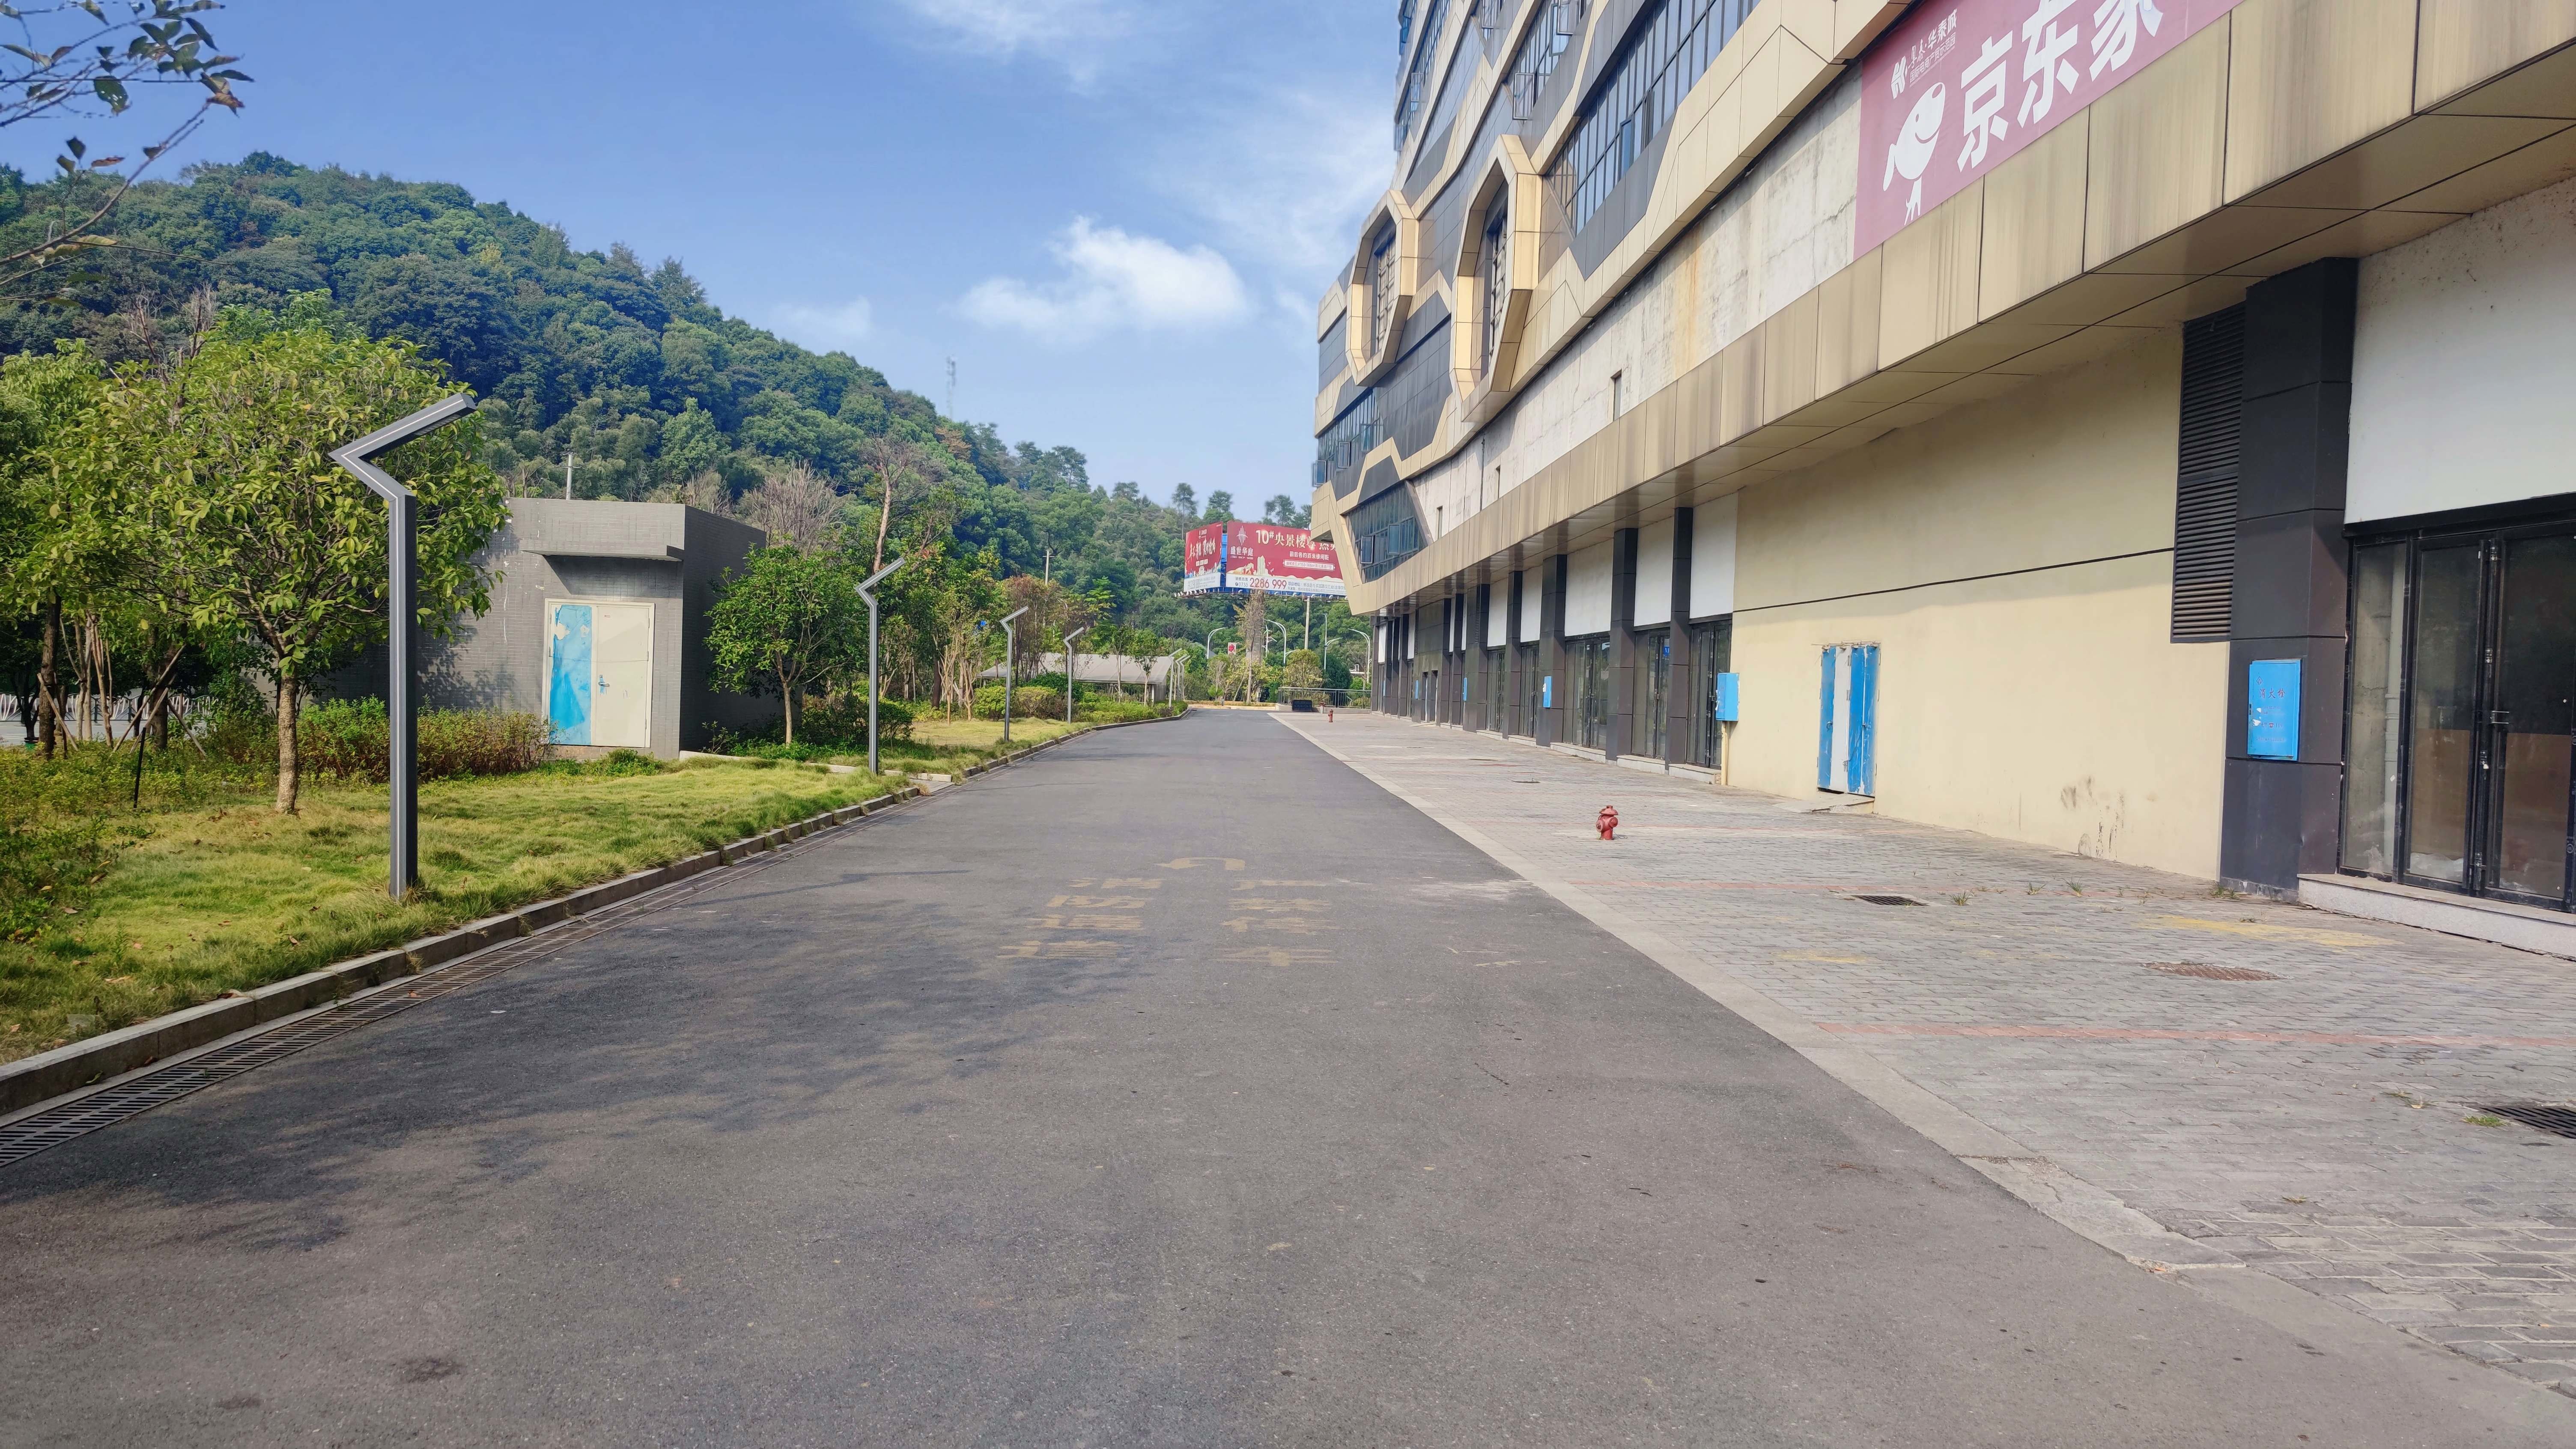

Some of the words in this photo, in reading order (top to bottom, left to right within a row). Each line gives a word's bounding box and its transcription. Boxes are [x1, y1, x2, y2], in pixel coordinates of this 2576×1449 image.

[1230, 546, 1253, 556] 盛世华庭
[1249, 577, 1270, 588] 2286
[1272, 579, 1287, 589] 999
[2259, 688, 2286, 699] 消火栓
